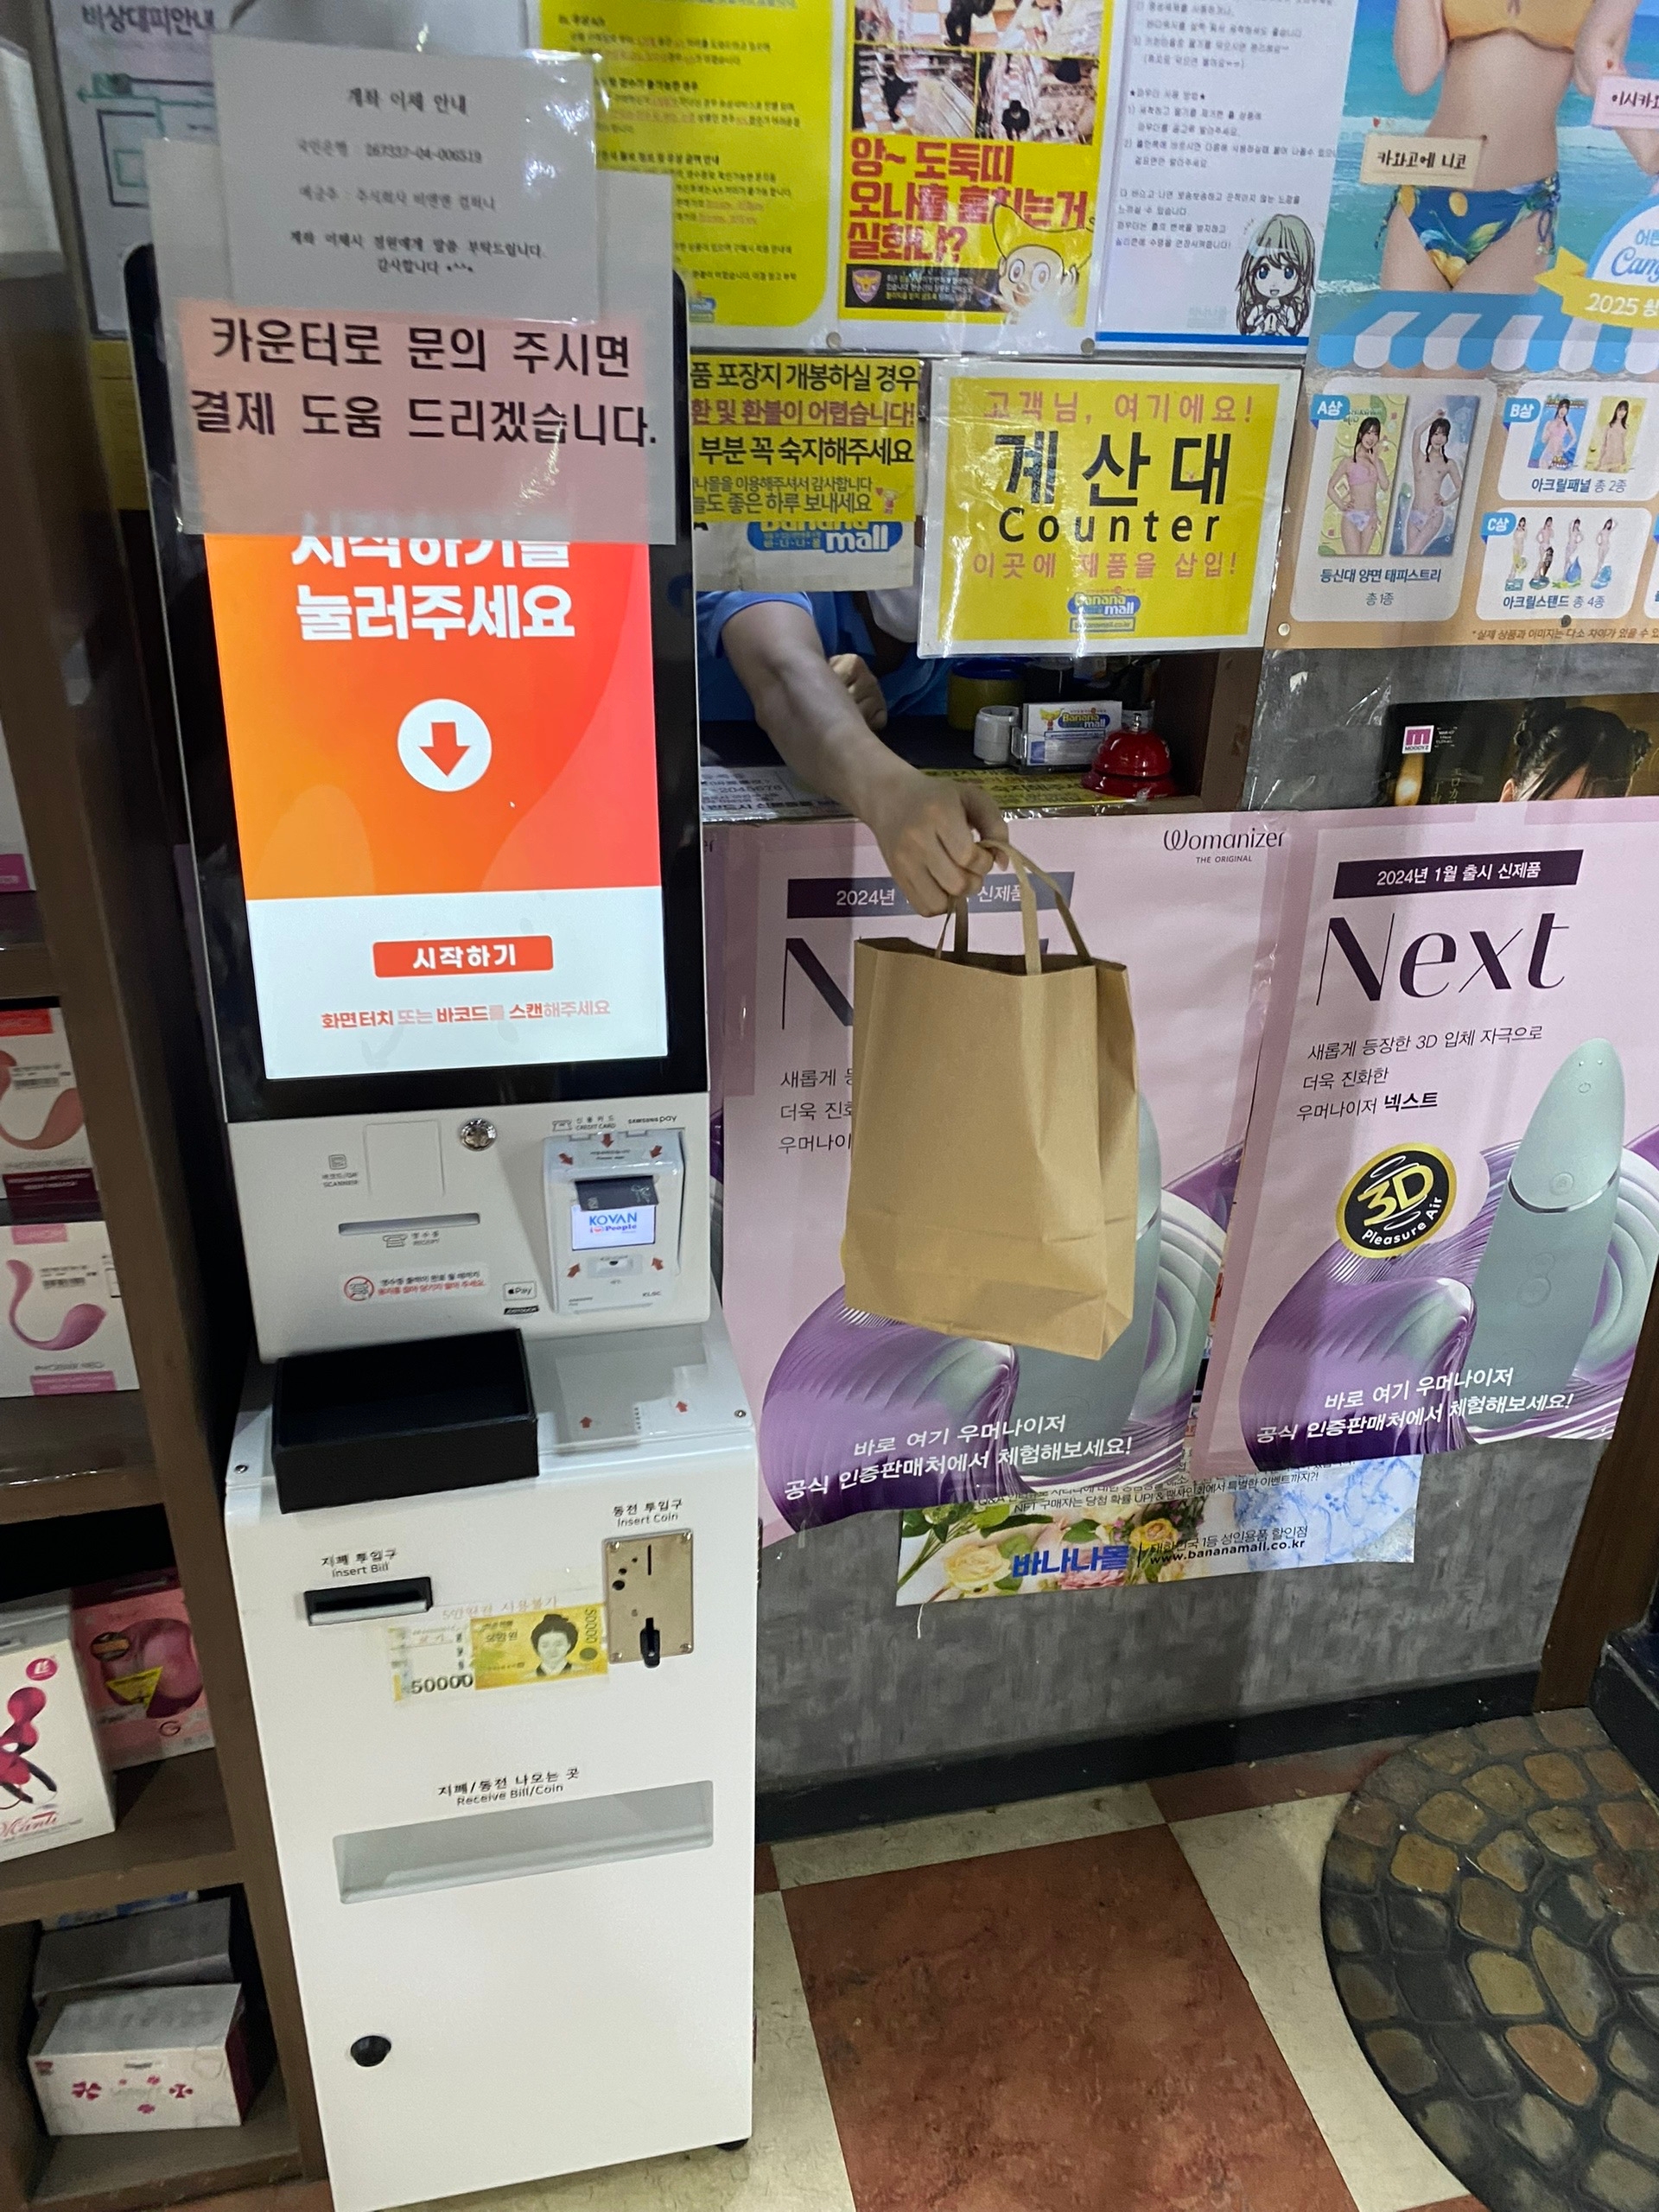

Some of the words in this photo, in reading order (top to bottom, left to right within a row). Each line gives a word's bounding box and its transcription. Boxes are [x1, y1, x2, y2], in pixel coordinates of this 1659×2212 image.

[82, 3, 214, 35] 비상대피안내
[349, 87, 380, 108] 계좌
[389, 89, 424, 111] 이체
[434, 92, 469, 116] 안내
[851, 137, 907, 179] 앙~
[915, 141, 1015, 184] 도둑띠
[1377, 150, 1436, 170] 카와고에
[1441, 151, 1468, 171] 니코
[377, 257, 440, 275] 감사합니다
[1585, 292, 1641, 317] 2025
[211, 317, 382, 367] 카운터로
[408, 327, 486, 372] 문의
[512, 329, 632, 380] 주시면
[716, 361, 781, 391] 포장지
[785, 362, 872, 391] 개봉하실
[876, 364, 919, 393] 경우
[191, 389, 275, 436] 결제
[302, 394, 382, 439] 도움
[407, 399, 658, 448] 드리겠습니다.
[716, 398, 740, 425] 및
[741, 398, 804, 426] 환불이
[809, 399, 915, 428] 어렵습니다!
[984, 391, 1092, 426] 고객님,
[1115, 392, 1254, 425] 여기에요!
[1317, 400, 1344, 416] A상
[1509, 404, 1535, 420] B상
[698, 435, 747, 466] 부분
[750, 436, 775, 465] 꼭
[778, 436, 915, 466] 숙지해주세요
[994, 429, 1232, 507] 계산대
[736, 476, 810, 492] 이용해주셔서
[812, 476, 873, 492] 감사합니다
[1531, 477, 1592, 493] 아크릴패널
[1593, 478, 1605, 493] 총
[1608, 479, 1628, 493] 2종
[727, 493, 763, 514] 좋은
[766, 492, 801, 514] 하루
[804, 493, 873, 514] 보내세요
[998, 505, 1221, 543] Counter
[1486, 518, 1510, 533] C상
[826, 524, 889, 551] mall
[973, 552, 1057, 580] 이곳에
[1078, 552, 1157, 580] 제품을
[1174, 551, 1238, 580] 삽입!
[1319, 569, 1356, 583] 등신대
[1358, 569, 1382, 584] 양면
[1384, 569, 1442, 583] 태피스트리
[296, 584, 575, 641] 눌러주세요
[1103, 601, 1135, 615] mall
[1365, 592, 1378, 607] 총
[1573, 595, 1585, 608] 총
[1587, 594, 1606, 609] 4종
[1497, 628, 1526, 640] 상품과
[1528, 628, 1565, 640] 이미지는
[1566, 627, 1586, 639] 다소
[1587, 627, 1618, 639] 차이가
[1619, 627, 1638, 639] 있을
[1639, 627, 1649, 639] 수
[1084, 718, 1107, 728] mall
[1163, 829, 1287, 853] Womanizer
[1196, 855, 1212, 864] THE
[1214, 854, 1253, 864] ORIGINAL
[1377, 868, 1427, 887] 2024년
[1434, 865, 1457, 885] 1월
[1462, 862, 1493, 882] 출시
[1497, 861, 1541, 880] 신제품
[836, 889, 896, 908] 2024년
[411, 942, 518, 970] 시작하기
[1316, 912, 1570, 1007] Next
[397, 1007, 434, 1027] 또는
[508, 1000, 612, 1021] 스캔해주세요
[1307, 1040, 1357, 1062] 새롭게
[1362, 1034, 1412, 1058] 등장한
[1414, 1032, 1439, 1051] 3D
[1443, 1030, 1476, 1049] 입체
[1479, 1025, 1544, 1046] 자극으로
[780, 1068, 836, 1088] 새롭게
[1302, 1071, 1336, 1093] 더욱
[1341, 1067, 1389, 1088] 진화한
[659, 1115, 678, 1123] pay
[780, 1102, 817, 1122] 더욱
[1295, 1097, 1378, 1122] 우머나이저
[1383, 1090, 1439, 1113] 넥스트
[1357, 1164, 1435, 1227] 3D
[589, 1211, 638, 1227] KOVAN
[605, 1224, 638, 1232] People
[1361, 1221, 1428, 1246] Pleasure
[1425, 1196, 1443, 1221] Air
[1324, 1390, 1365, 1413] 바로
[1371, 1380, 1410, 1405] 여기
[1415, 1366, 1515, 1396] 우머나이저
[1256, 1421, 1297, 1444] 공식
[1306, 1403, 1443, 1440] 인증판매처에서
[1448, 1393, 1574, 1421] 체험해보세요!
[853, 1436, 897, 1459] 바로
[905, 1427, 950, 1452] 여기
[956, 1414, 1067, 1445] 우머나이저
[784, 1477, 830, 1503] 공식
[838, 1454, 990, 1492] 인증판매처에서
[996, 1438, 1133, 1476] 체험해보세요!
[1039, 1497, 1084, 1510] 구매자는
[1085, 1495, 1109, 1507] 당첨
[1110, 1493, 1133, 1506] 확률
[1155, 1491, 1165, 1502] &
[1227, 1478, 1260, 1492] 특별한
[1260, 1471, 1319, 1488] 이벤트까지?!
[612, 1502, 639, 1517] 동전
[643, 1497, 683, 1515] 투입구
[616, 1514, 652, 1528] Insert
[653, 1511, 680, 1524] Coin
[1202, 1535, 1218, 1548] 1등
[1220, 1529, 1269, 1544] 성인용품
[1271, 1524, 1309, 1541] 할인점
[321, 1554, 350, 1569] 지폐
[354, 1548, 399, 1566] 투입구
[1012, 1543, 1130, 1580] 바나나몰
[1149, 1538, 1306, 1565] www.bananamall.co.kr
[331, 1564, 368, 1579] Insert
[370, 1561, 391, 1575] Bill
[584, 1608, 598, 1644] 50000
[410, 1673, 474, 1694] 50000
[437, 1777, 509, 1798] 지폐/동전
[514, 1769, 561, 1788] 나오는
[566, 1766, 581, 1782] 곳
[456, 1790, 508, 1808] Receive
[510, 1782, 564, 1802] Bill/Coin
